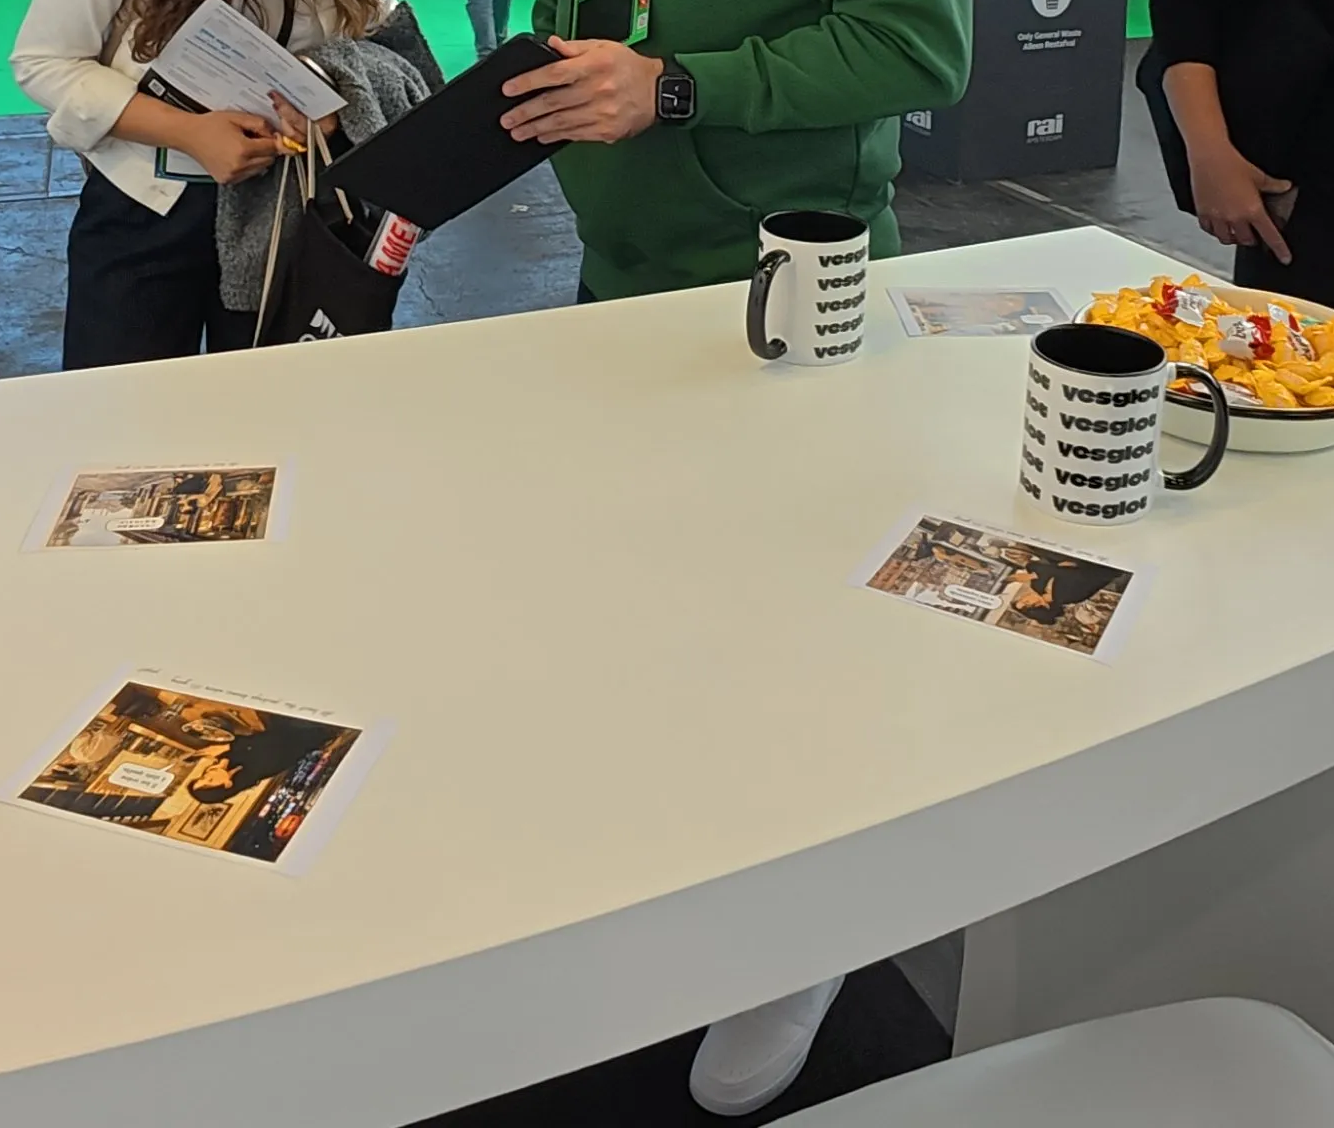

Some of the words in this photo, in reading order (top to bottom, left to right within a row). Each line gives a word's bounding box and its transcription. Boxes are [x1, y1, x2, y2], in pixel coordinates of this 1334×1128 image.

[1017, 32, 1033, 41] Only
[1034, 30, 1060, 40] General
[906, 110, 932, 130] rai
[1027, 113, 1064, 137] rai
